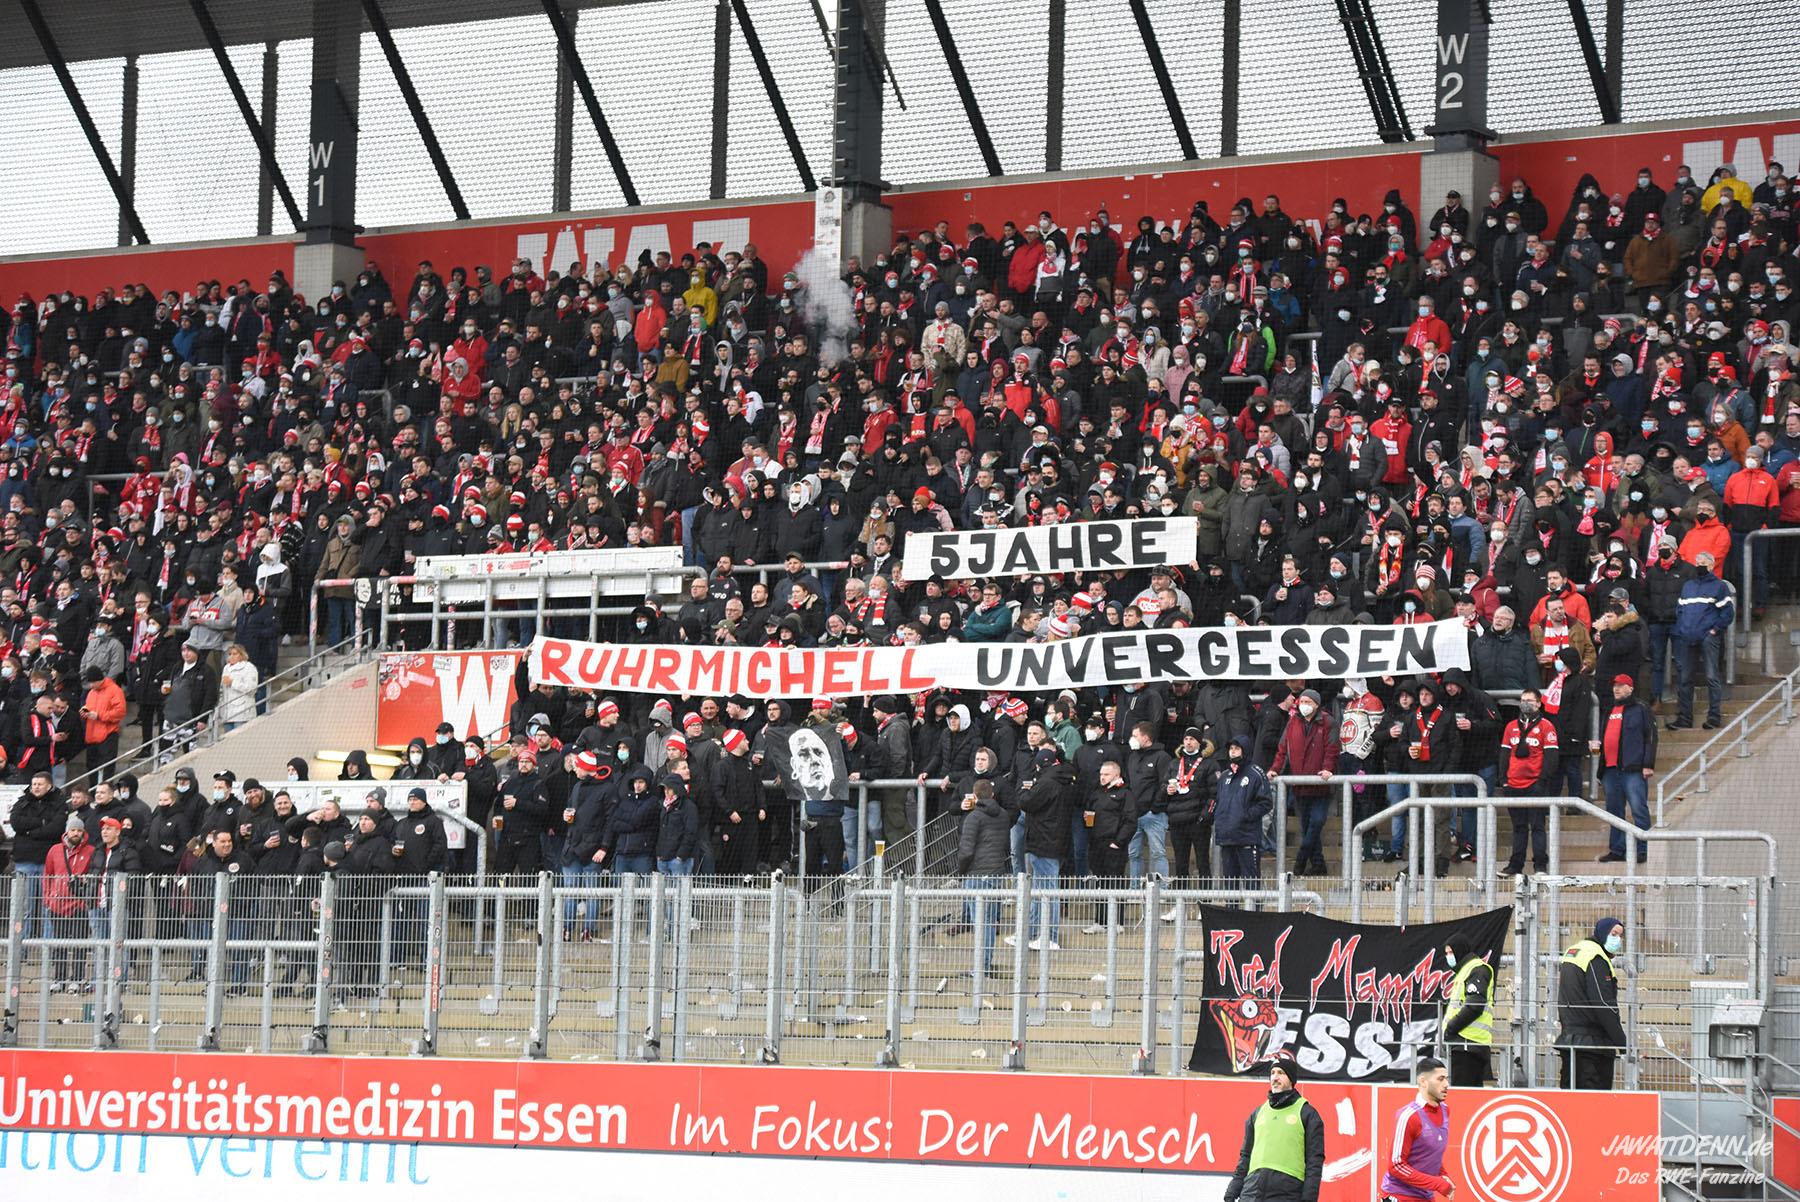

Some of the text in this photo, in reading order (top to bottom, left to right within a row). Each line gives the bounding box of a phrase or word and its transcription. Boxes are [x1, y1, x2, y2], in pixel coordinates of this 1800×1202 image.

[1438, 33, 1470, 66] W
[1440, 71, 1464, 110] 2
[309, 141, 334, 169] W
[313, 175, 326, 207] 1
[541, 625, 1437, 692] RUHRMICHELL UNVERGESSEN
[1210, 925, 1492, 1027] Red Mamba
[1264, 1006, 1440, 1079] ESSE
[0, 1074, 1215, 1164] Universitätsmedizin Essen Im Fokus: Der Mensch
